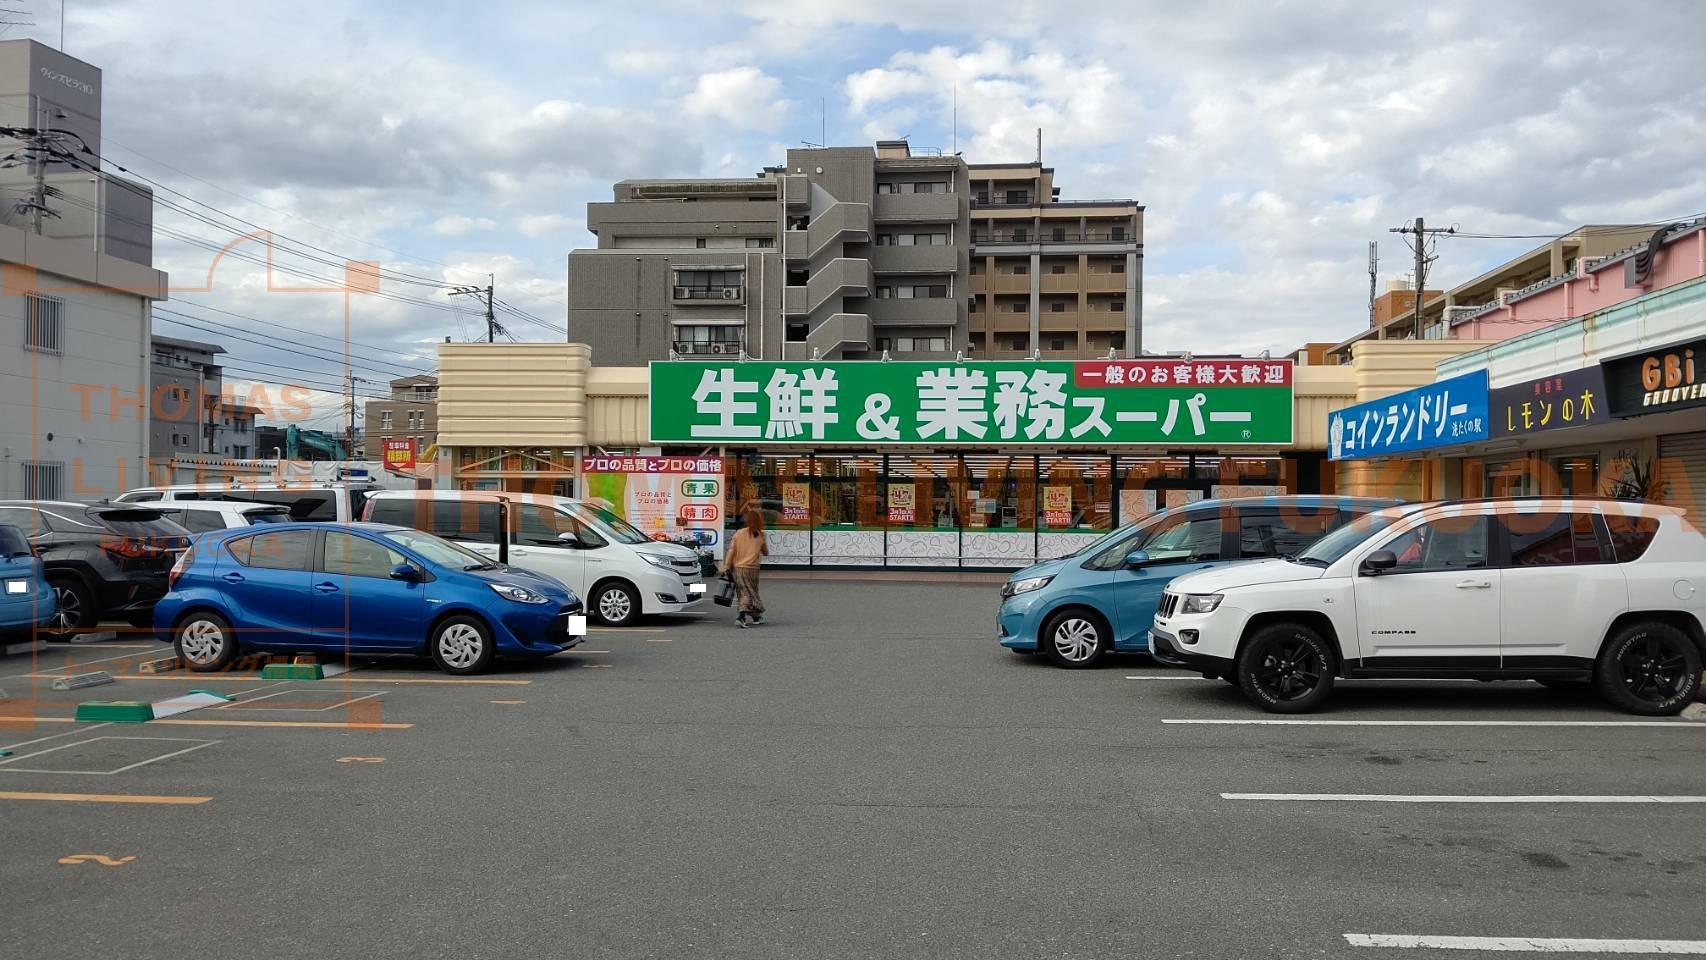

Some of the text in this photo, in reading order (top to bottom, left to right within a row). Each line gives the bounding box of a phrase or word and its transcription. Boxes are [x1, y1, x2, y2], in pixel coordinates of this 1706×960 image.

[1082, 364, 1285, 385] 一般のお客様大歓迎
[1345, 390, 1468, 450] コインランドリー
[584, 459, 722, 472] プロの品質とプロの価格
[685, 483, 715, 494] 青果
[684, 508, 715, 518] 精肉
